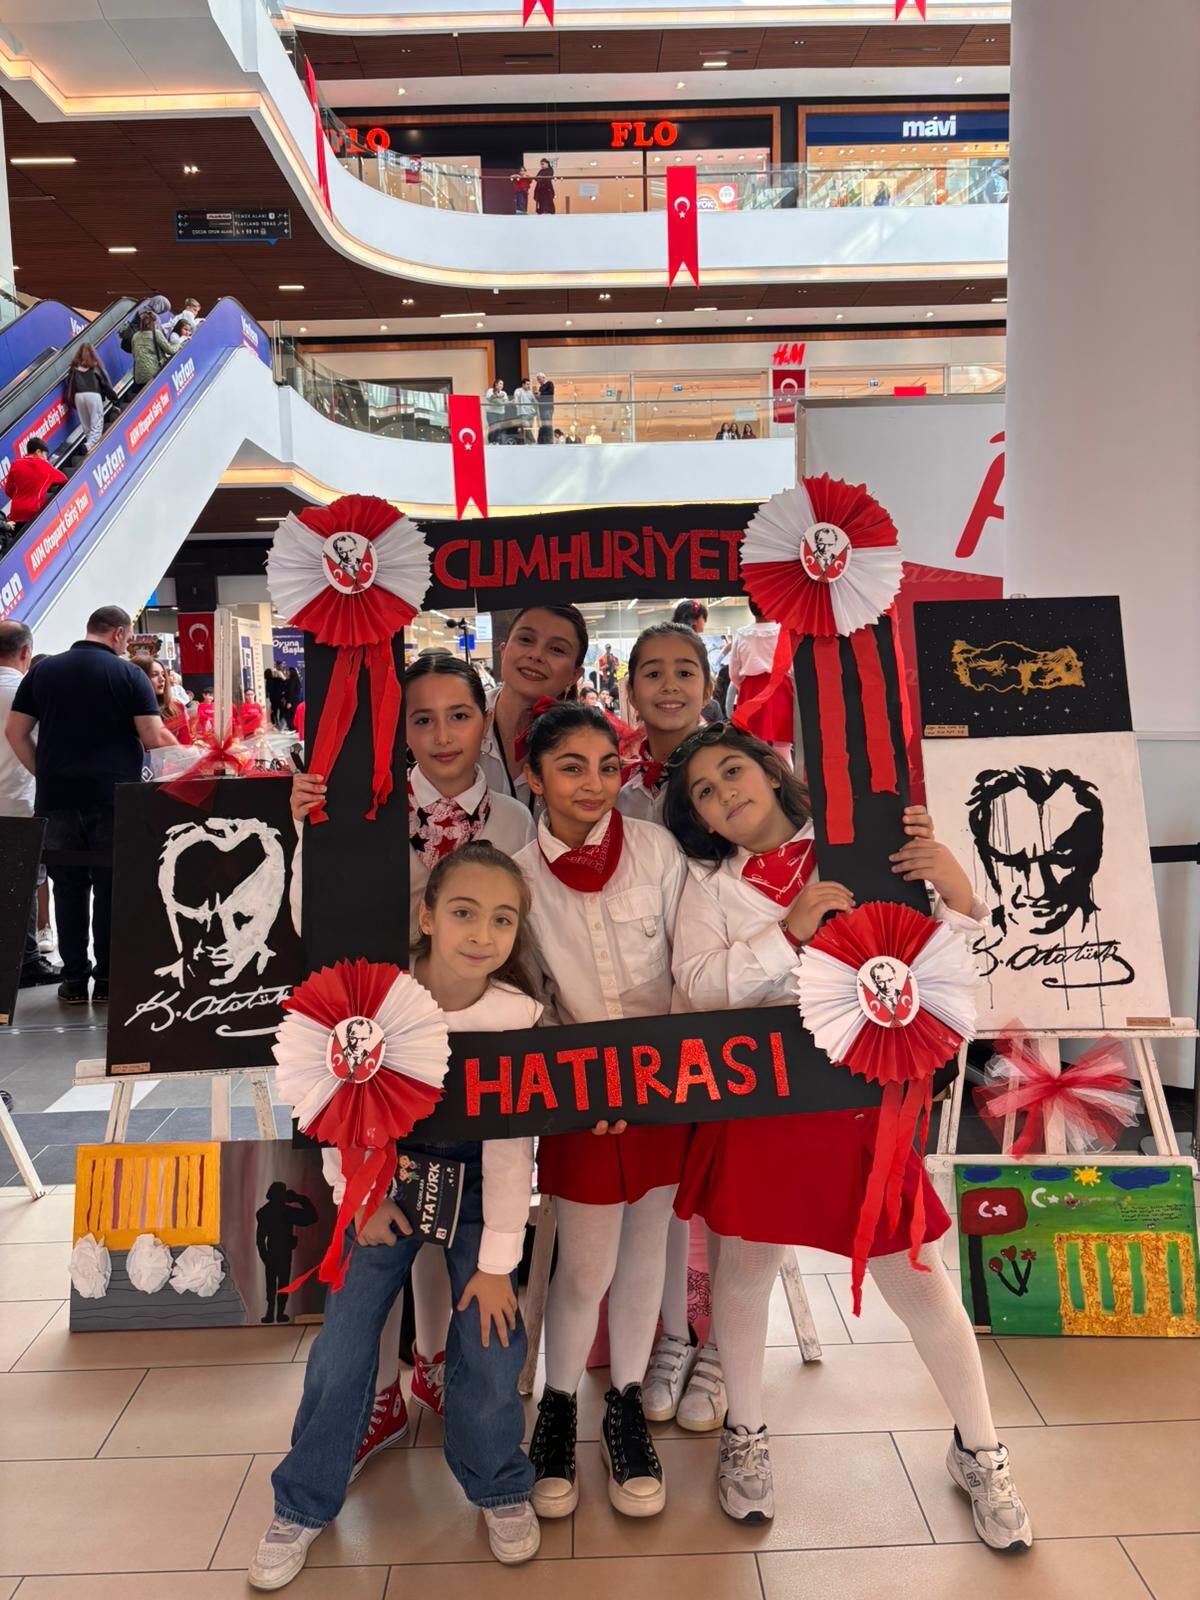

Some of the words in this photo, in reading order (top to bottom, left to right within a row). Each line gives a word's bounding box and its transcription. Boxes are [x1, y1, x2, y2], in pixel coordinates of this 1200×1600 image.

[611, 121, 678, 147] FLO
[171, 357, 195, 391] Vatan
[92, 445, 125, 488] Vatan
[30, 543, 47, 571] AVM
[43, 519, 67, 554] Otopark
[272, 639, 299, 649] Oyuna
[464, 1031, 791, 1117] HATIRASI
[420, 1162, 441, 1234] ATATÜRK
